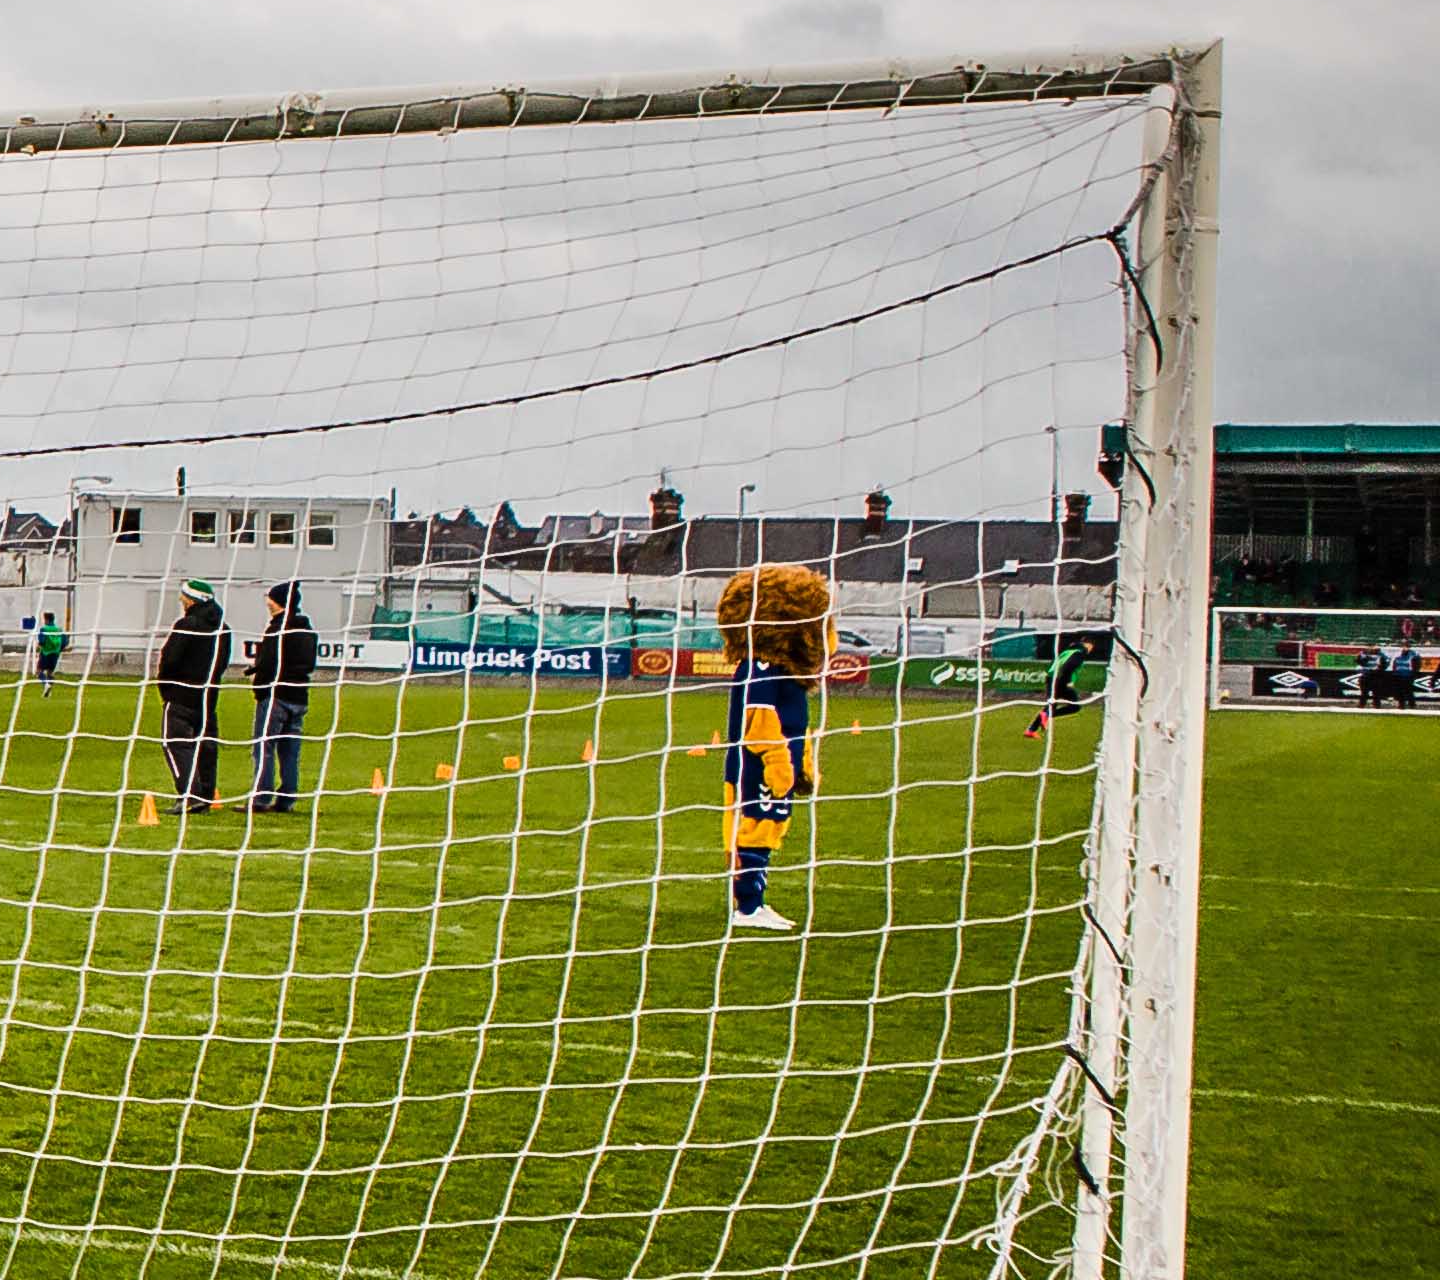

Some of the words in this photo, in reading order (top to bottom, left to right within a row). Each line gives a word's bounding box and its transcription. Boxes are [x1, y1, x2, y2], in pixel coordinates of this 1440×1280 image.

[416, 646, 526, 668] Limerick
[536, 649, 592, 670] Post
[955, 665, 990, 682] sse
[992, 666, 1048, 683] Airtricit
